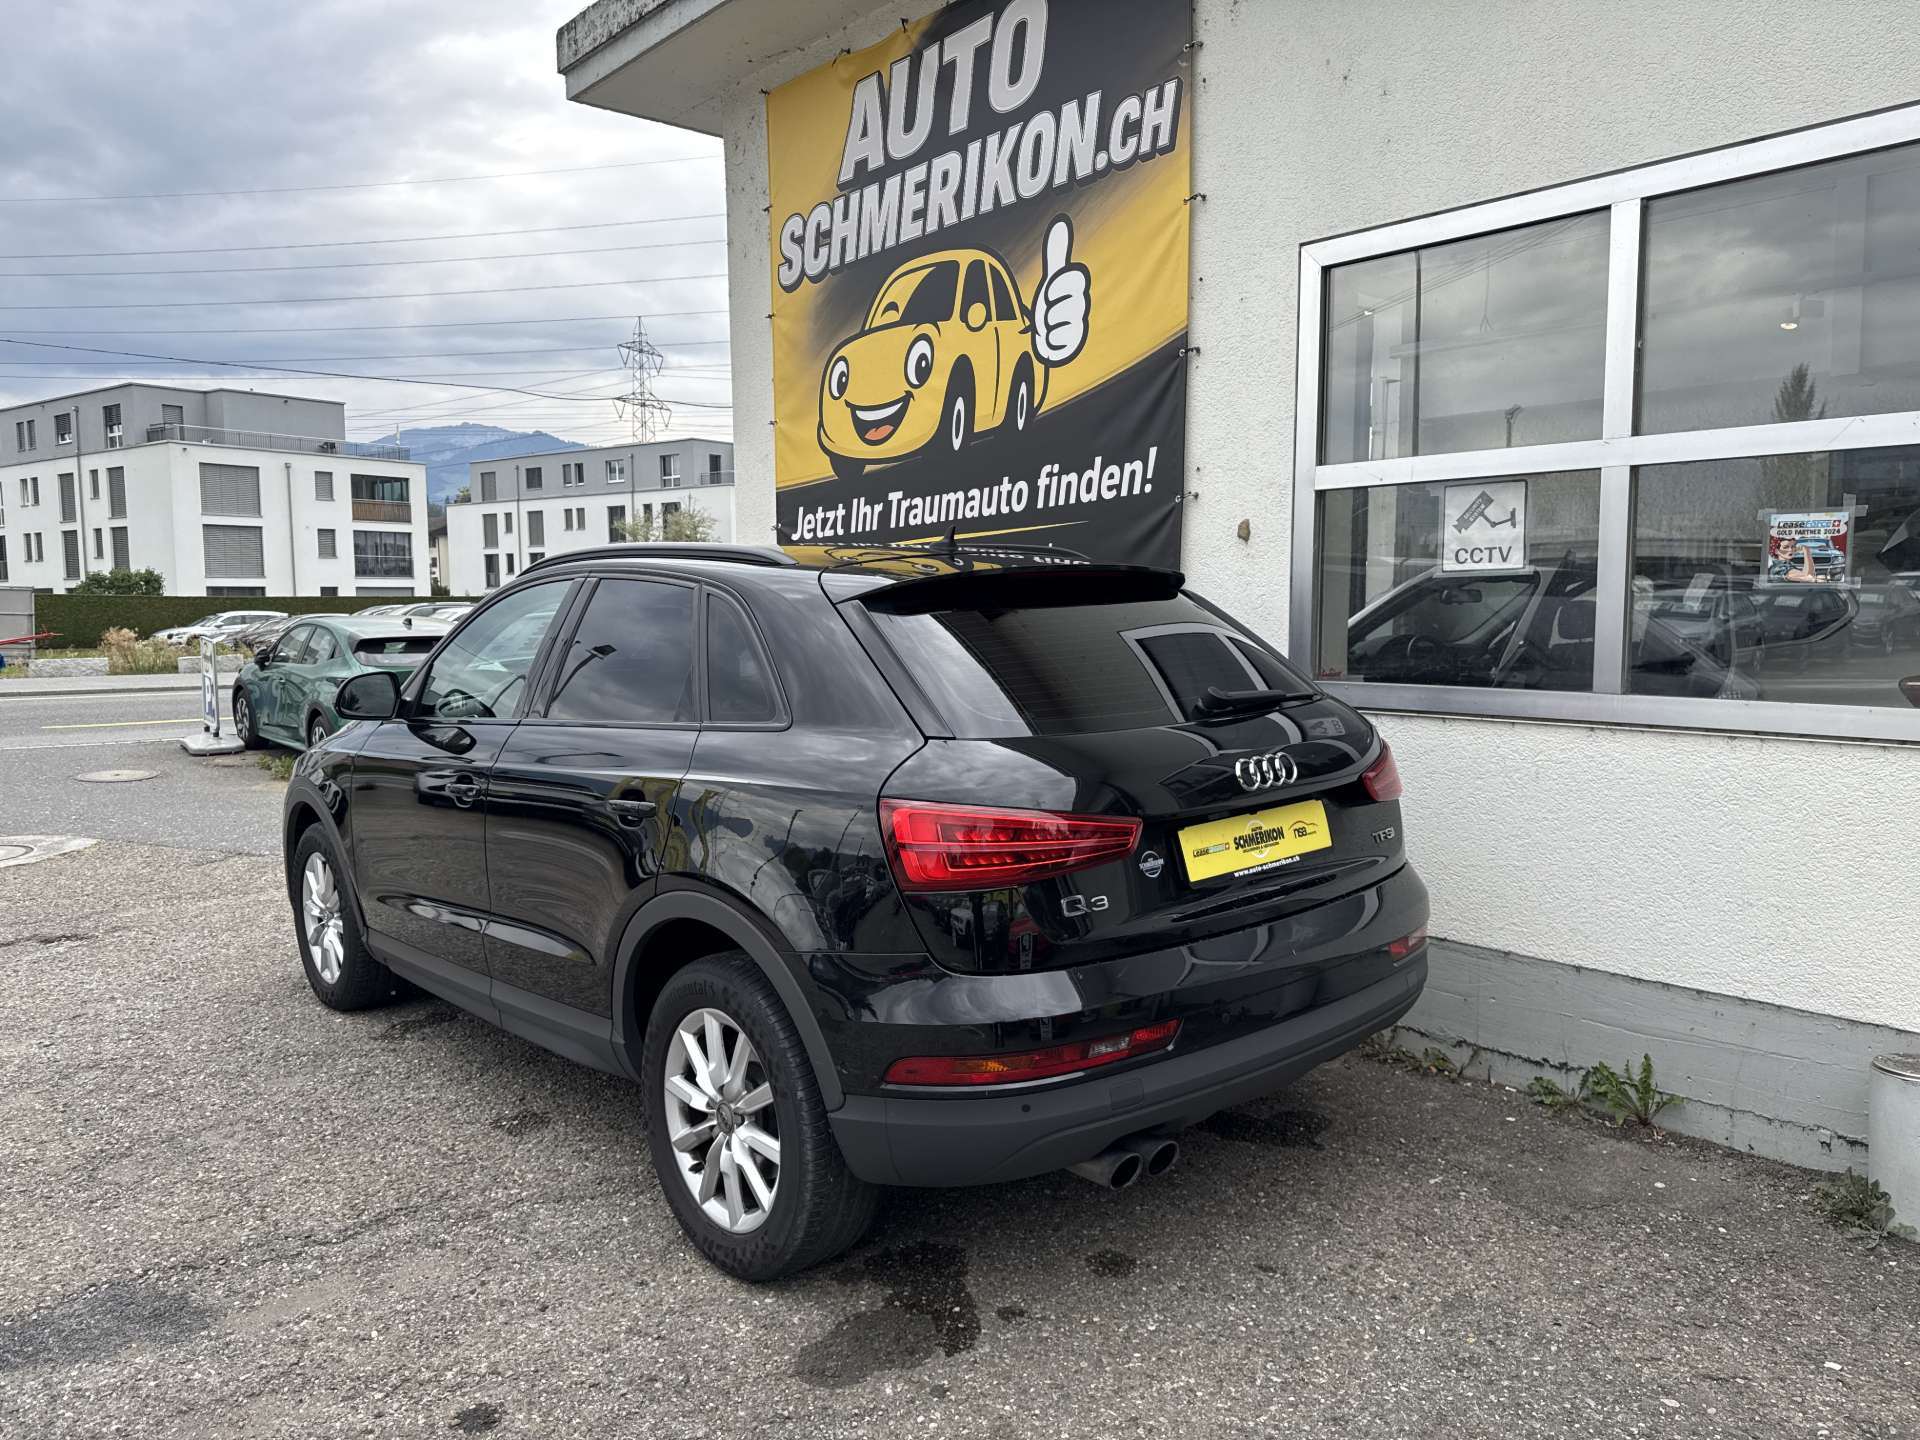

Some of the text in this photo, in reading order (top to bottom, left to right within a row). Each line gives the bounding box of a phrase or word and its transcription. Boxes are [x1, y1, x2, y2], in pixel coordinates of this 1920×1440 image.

[837, 0, 1048, 185] AUTO
[778, 78, 1181, 290] SCHMERIKON.CH
[791, 446, 1158, 541] Jetzt Ihr Traumauto finden!
[1454, 545, 1512, 565] CCTV
[1233, 826, 1285, 850] SCHMERIKON
[1060, 894, 1110, 918] Q3
